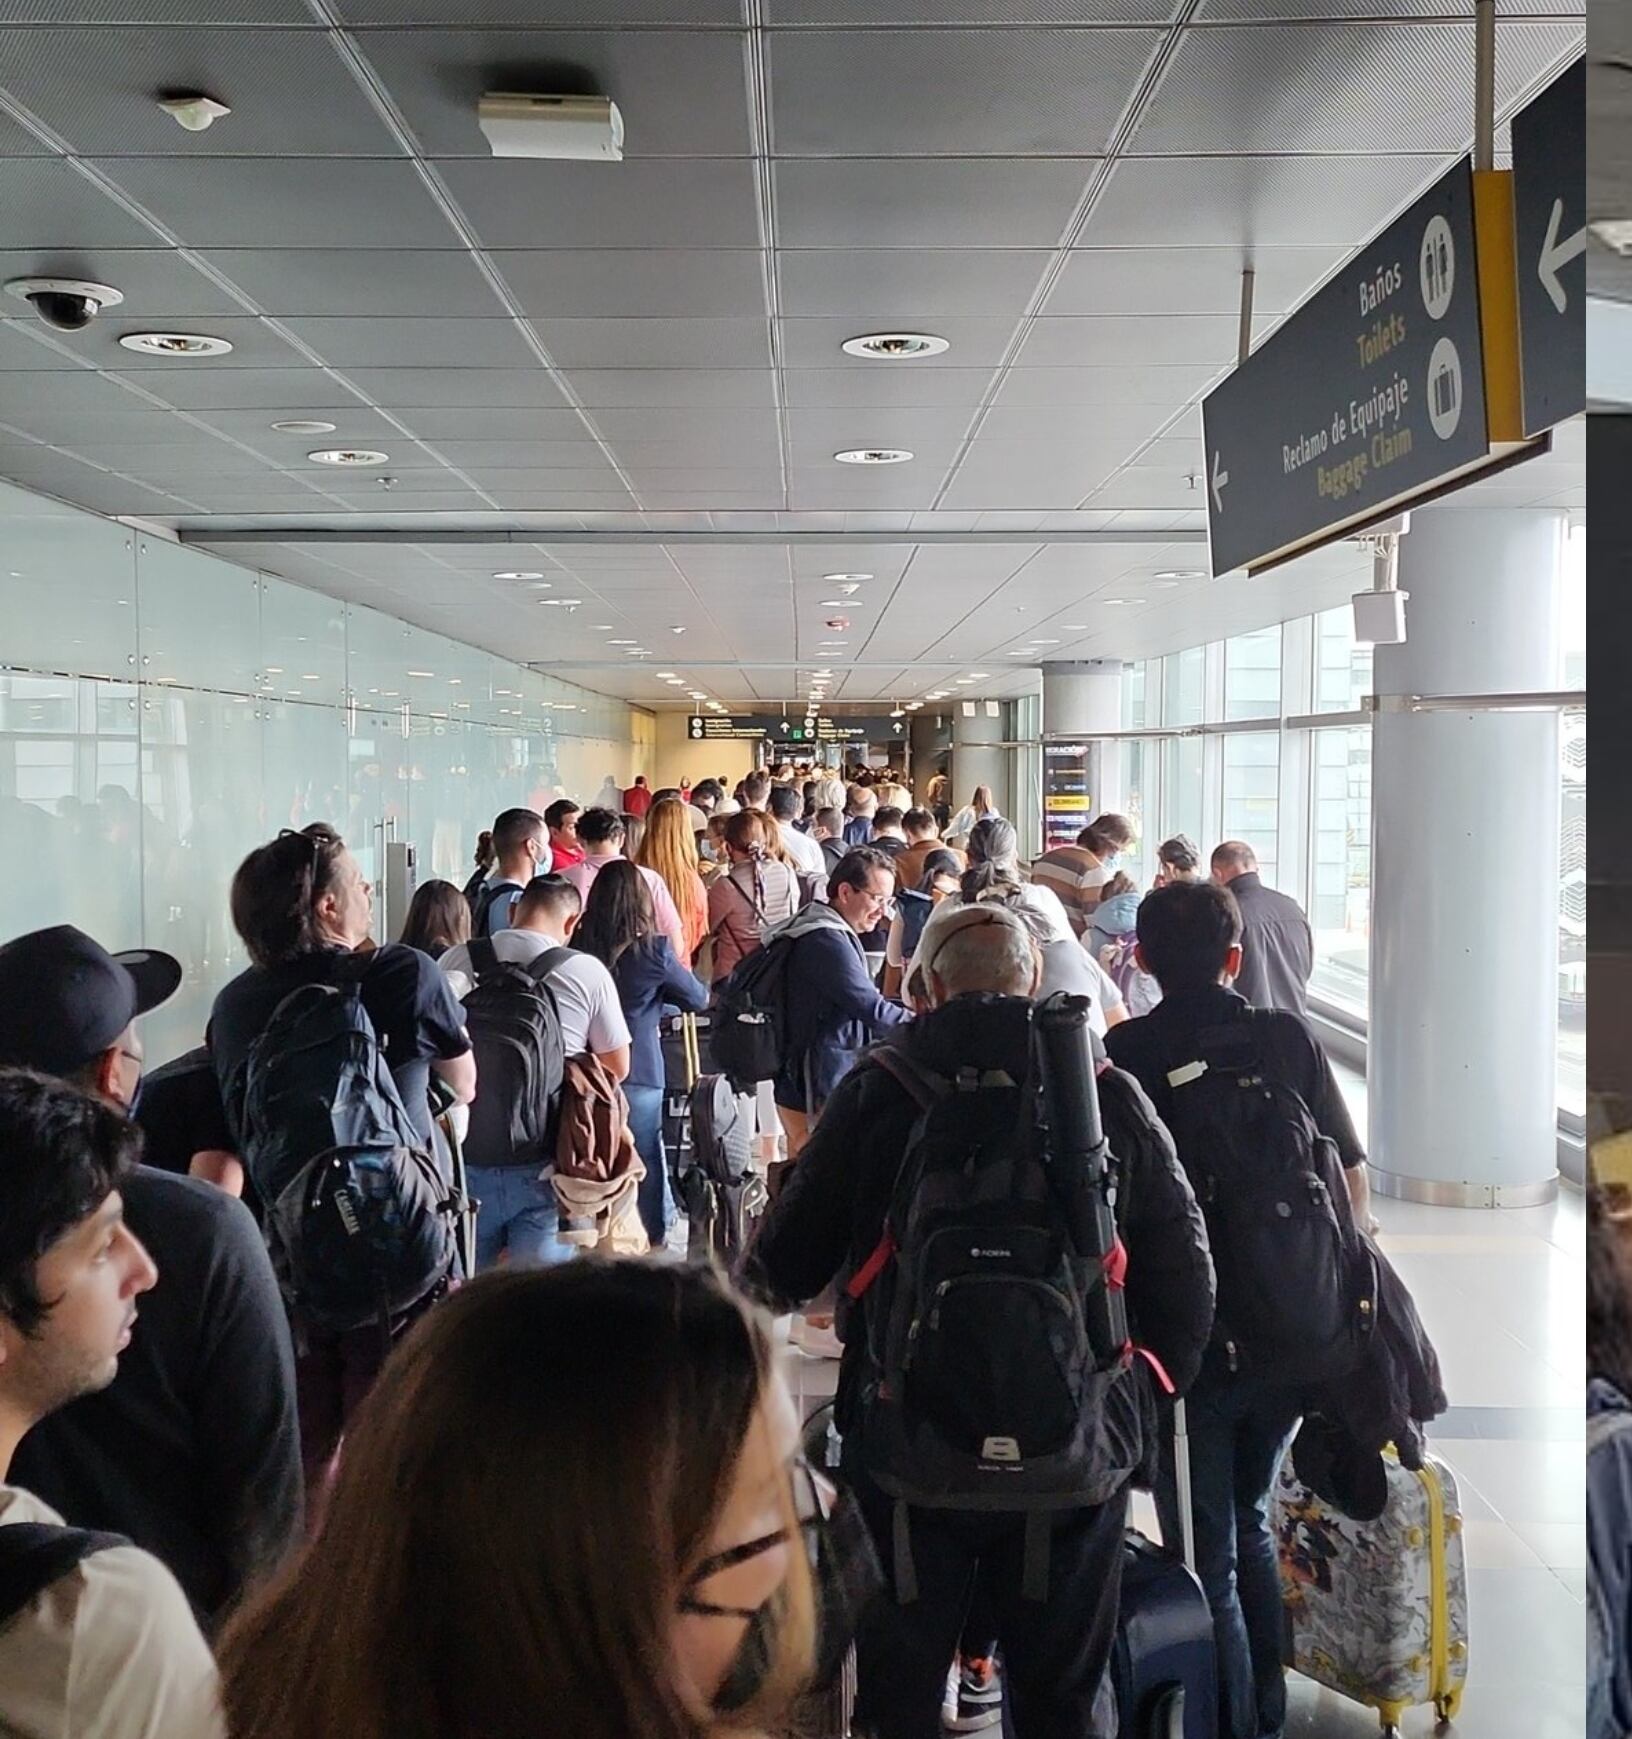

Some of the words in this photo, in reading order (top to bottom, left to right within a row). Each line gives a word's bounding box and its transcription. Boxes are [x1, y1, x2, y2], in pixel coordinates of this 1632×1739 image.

[1359, 262, 1402, 317] Baños
[1356, 312, 1406, 369] Toilets
[1282, 429, 1328, 474] Reclamo
[1331, 411, 1347, 446] de
[1349, 370, 1409, 440] Equipaje
[1317, 452, 1368, 500] Baggage
[1371, 423, 1412, 468] Claim
